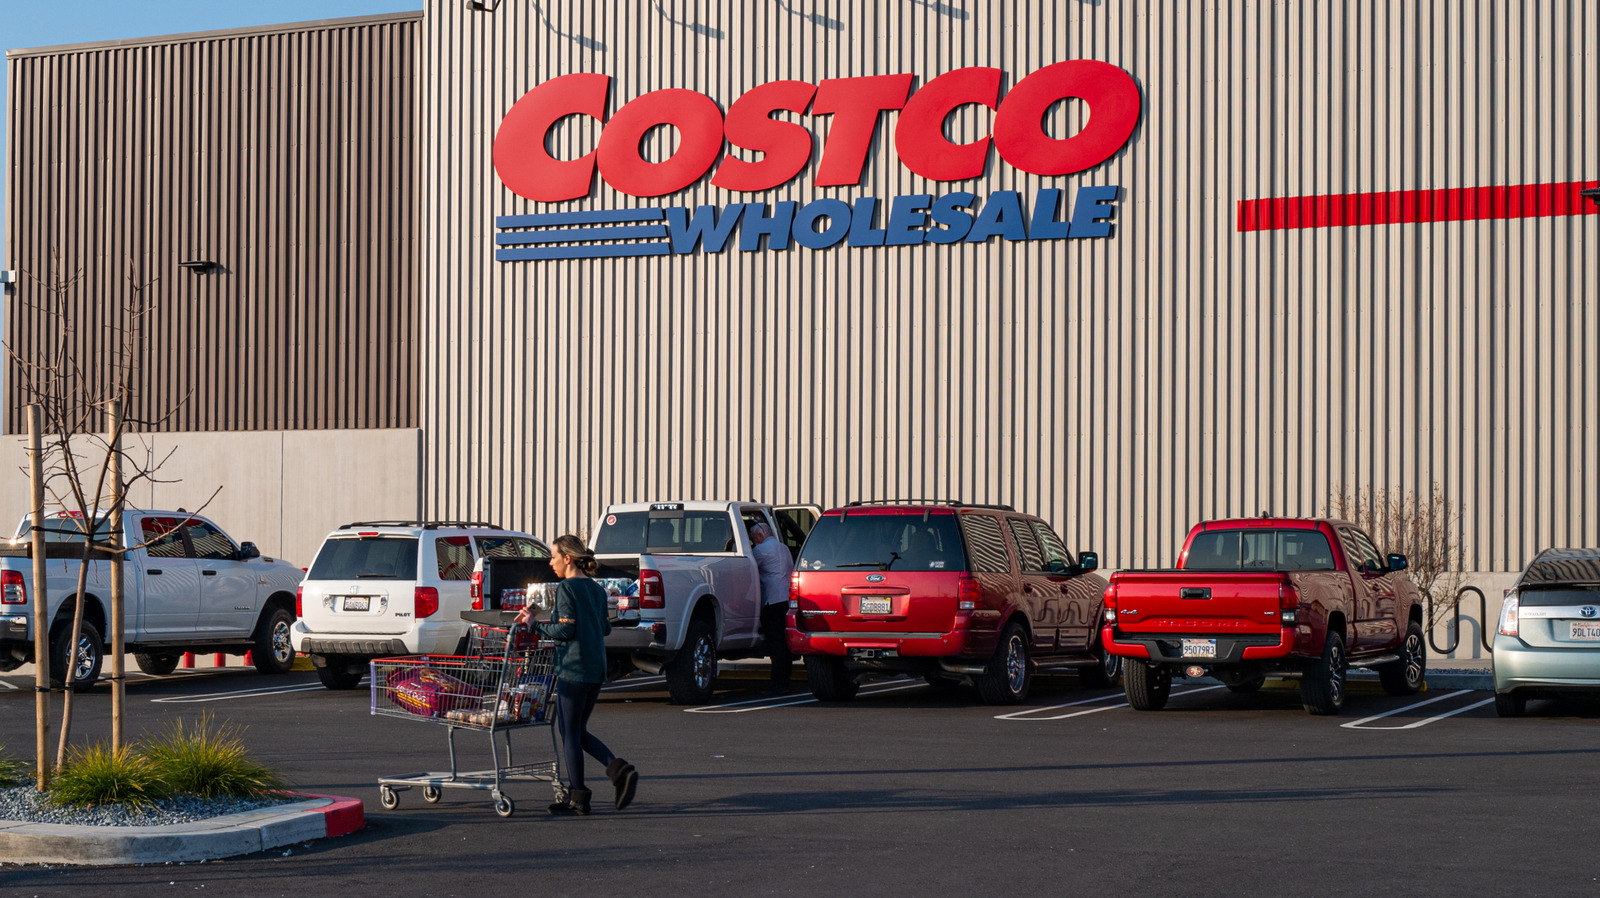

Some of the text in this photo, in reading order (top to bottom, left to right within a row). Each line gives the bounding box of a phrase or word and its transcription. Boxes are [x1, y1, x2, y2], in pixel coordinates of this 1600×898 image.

[493, 59, 1141, 203] COSTCO
[666, 185, 1119, 255] WHOLESALE
[1152, 620, 1247, 628] TACOMA
[1184, 645, 1215, 655] 95079R3
